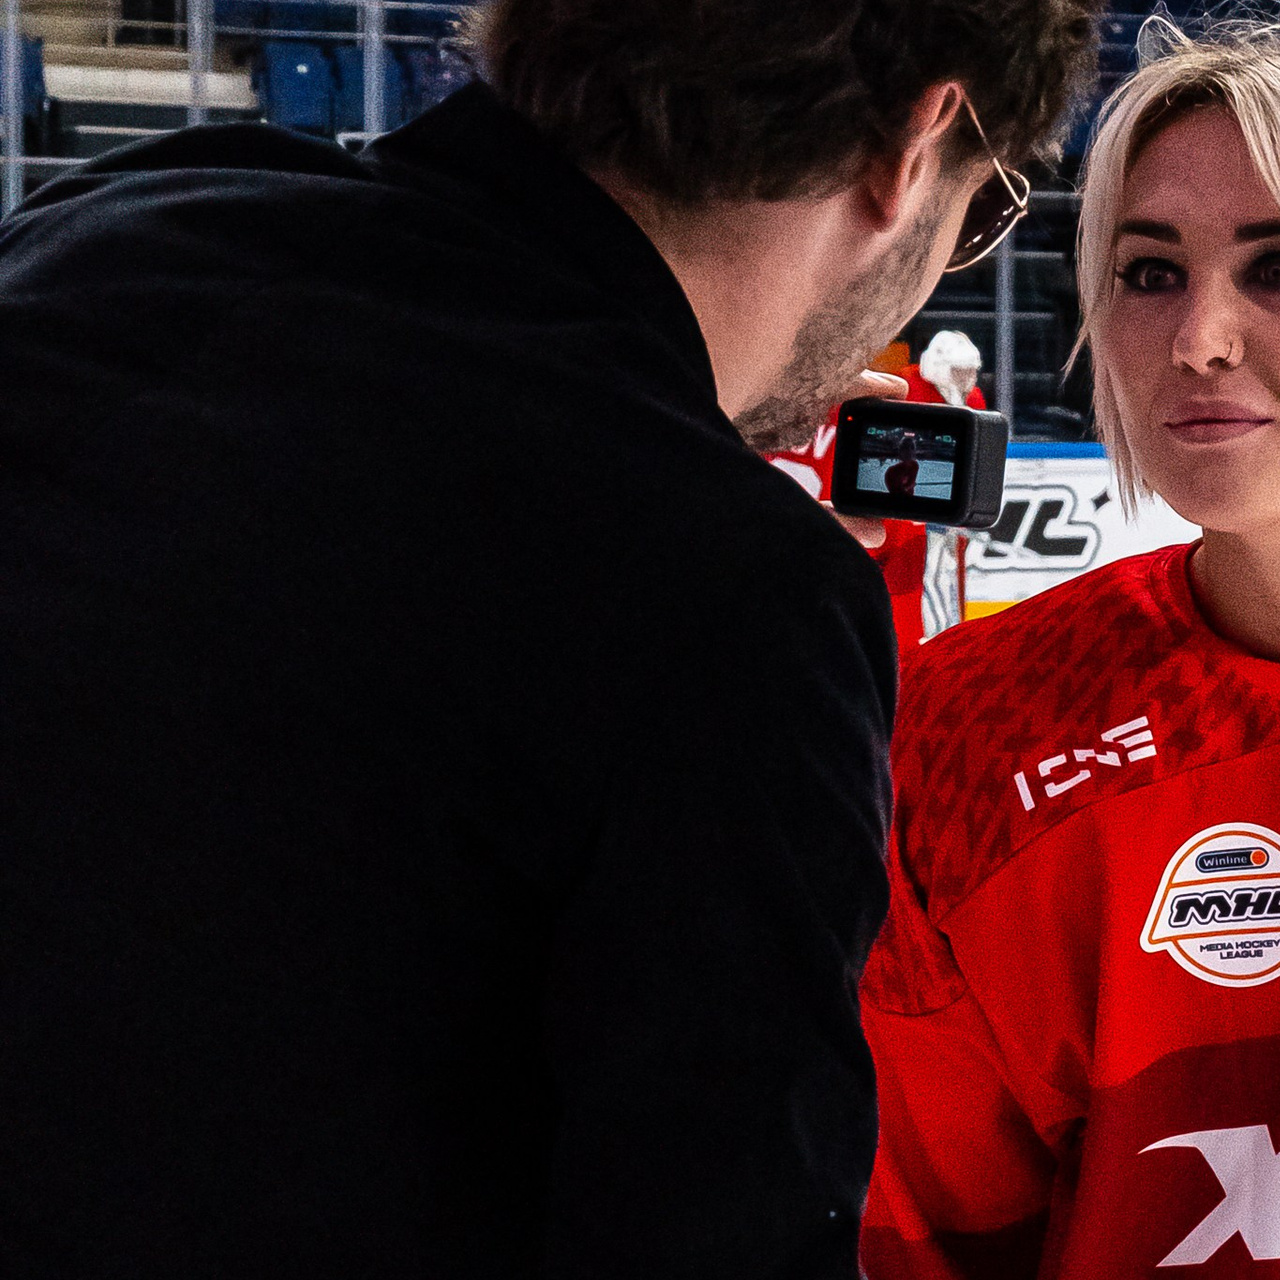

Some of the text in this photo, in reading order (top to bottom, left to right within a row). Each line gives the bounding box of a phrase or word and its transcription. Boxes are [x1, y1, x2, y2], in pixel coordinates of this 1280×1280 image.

[1203, 855, 1248, 867] Winline
[1200, 939, 1280, 952] MEDIA HOCKEY
[1219, 950, 1264, 960] LEAGUE
